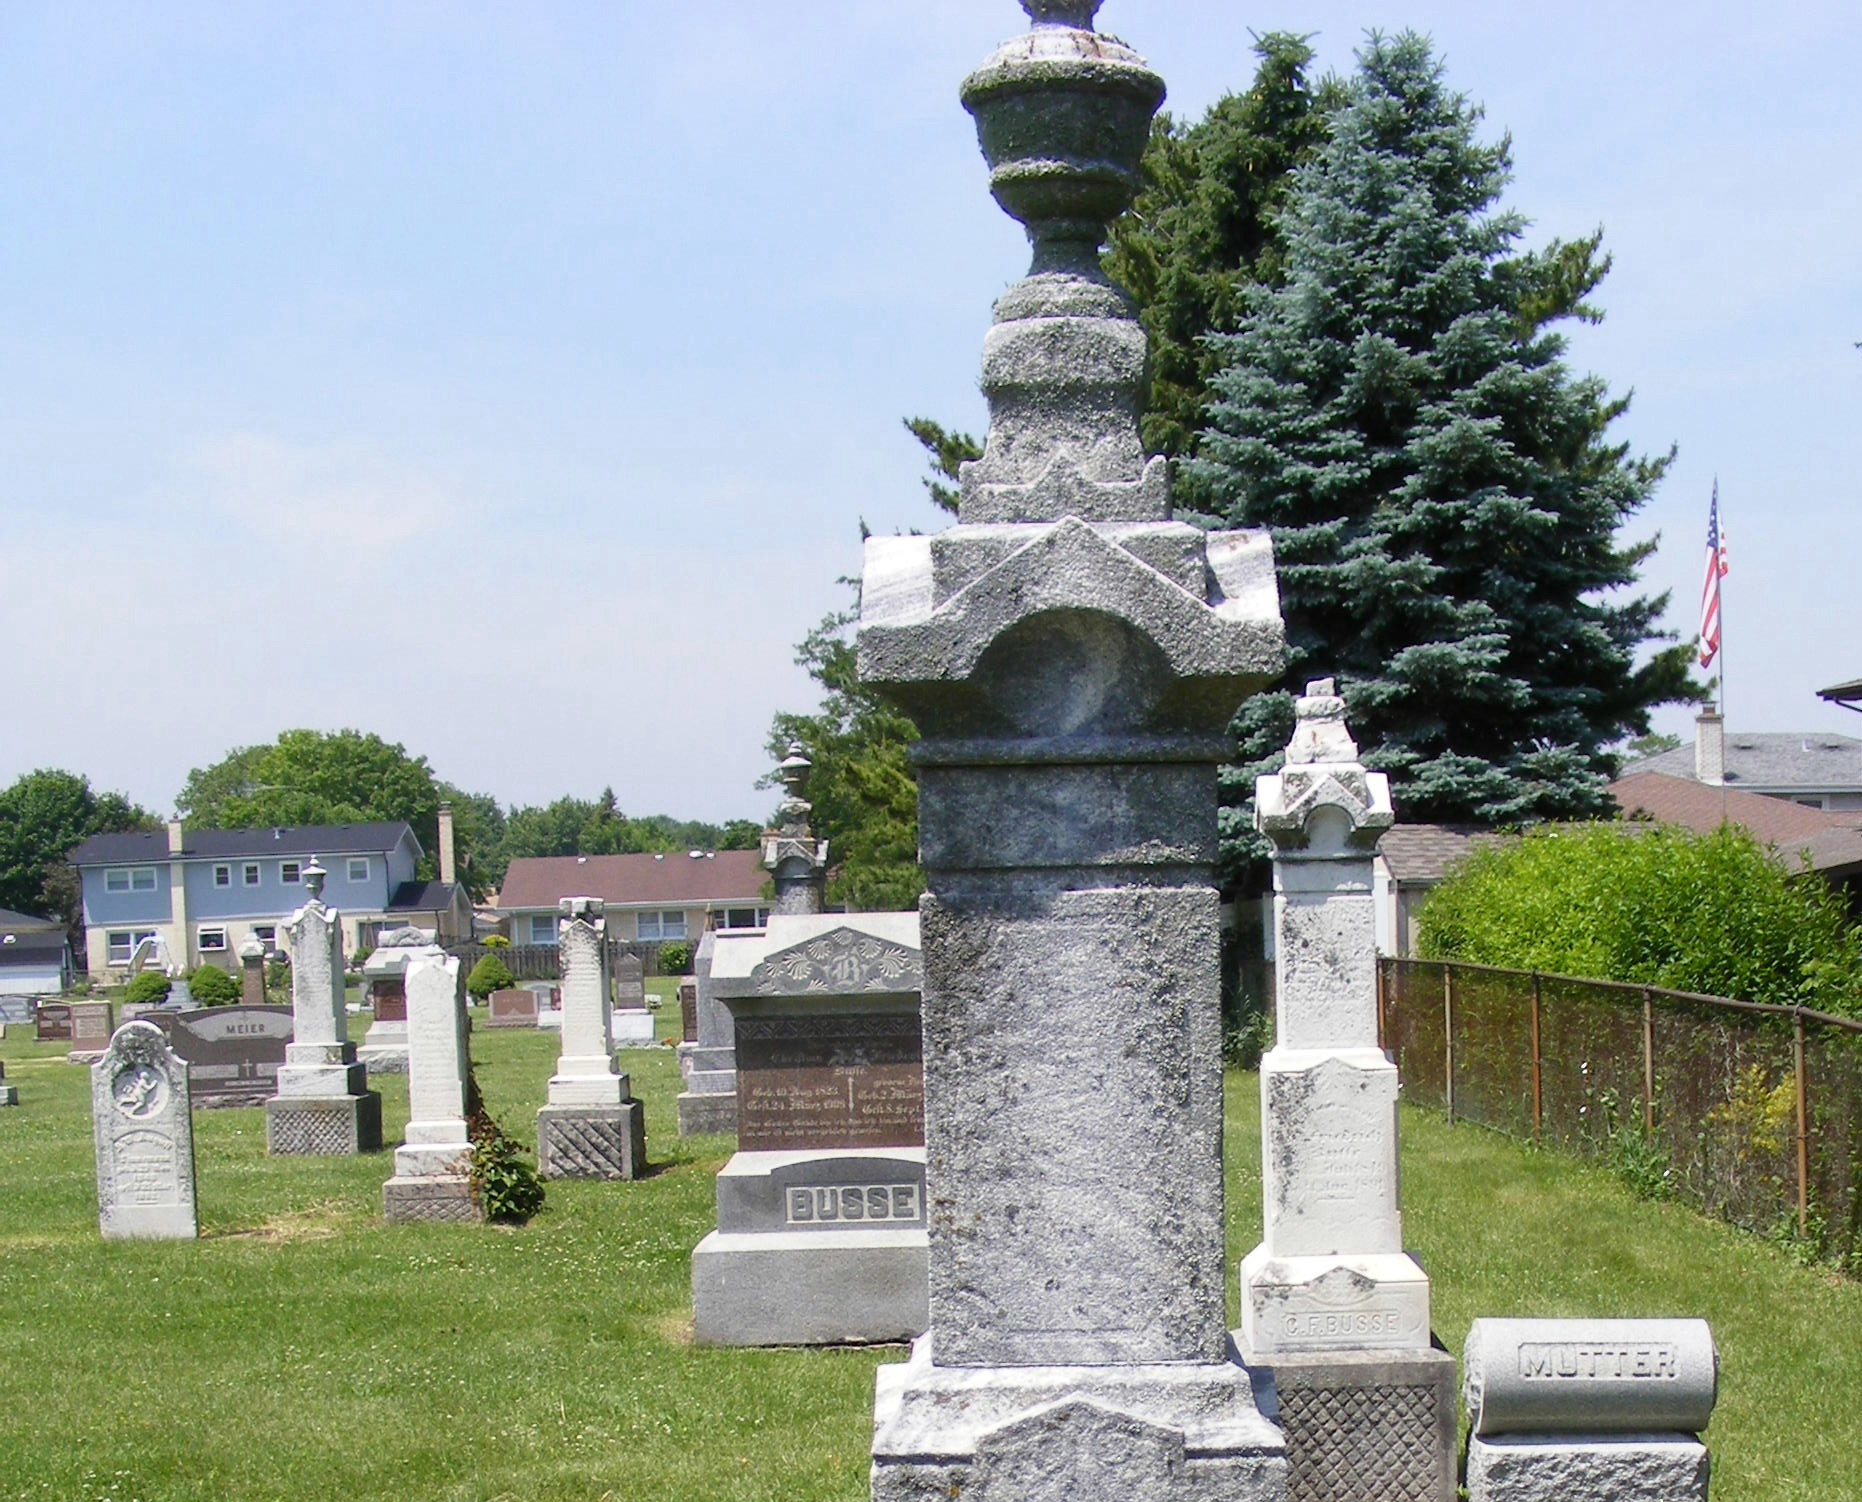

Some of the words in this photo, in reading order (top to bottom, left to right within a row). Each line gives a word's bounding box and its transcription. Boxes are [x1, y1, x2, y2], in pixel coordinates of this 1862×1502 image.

[226, 1024, 265, 1034] MEIER
[791, 1187, 915, 1220] BUSSE
[1524, 1346, 1676, 1378] MUTTER
